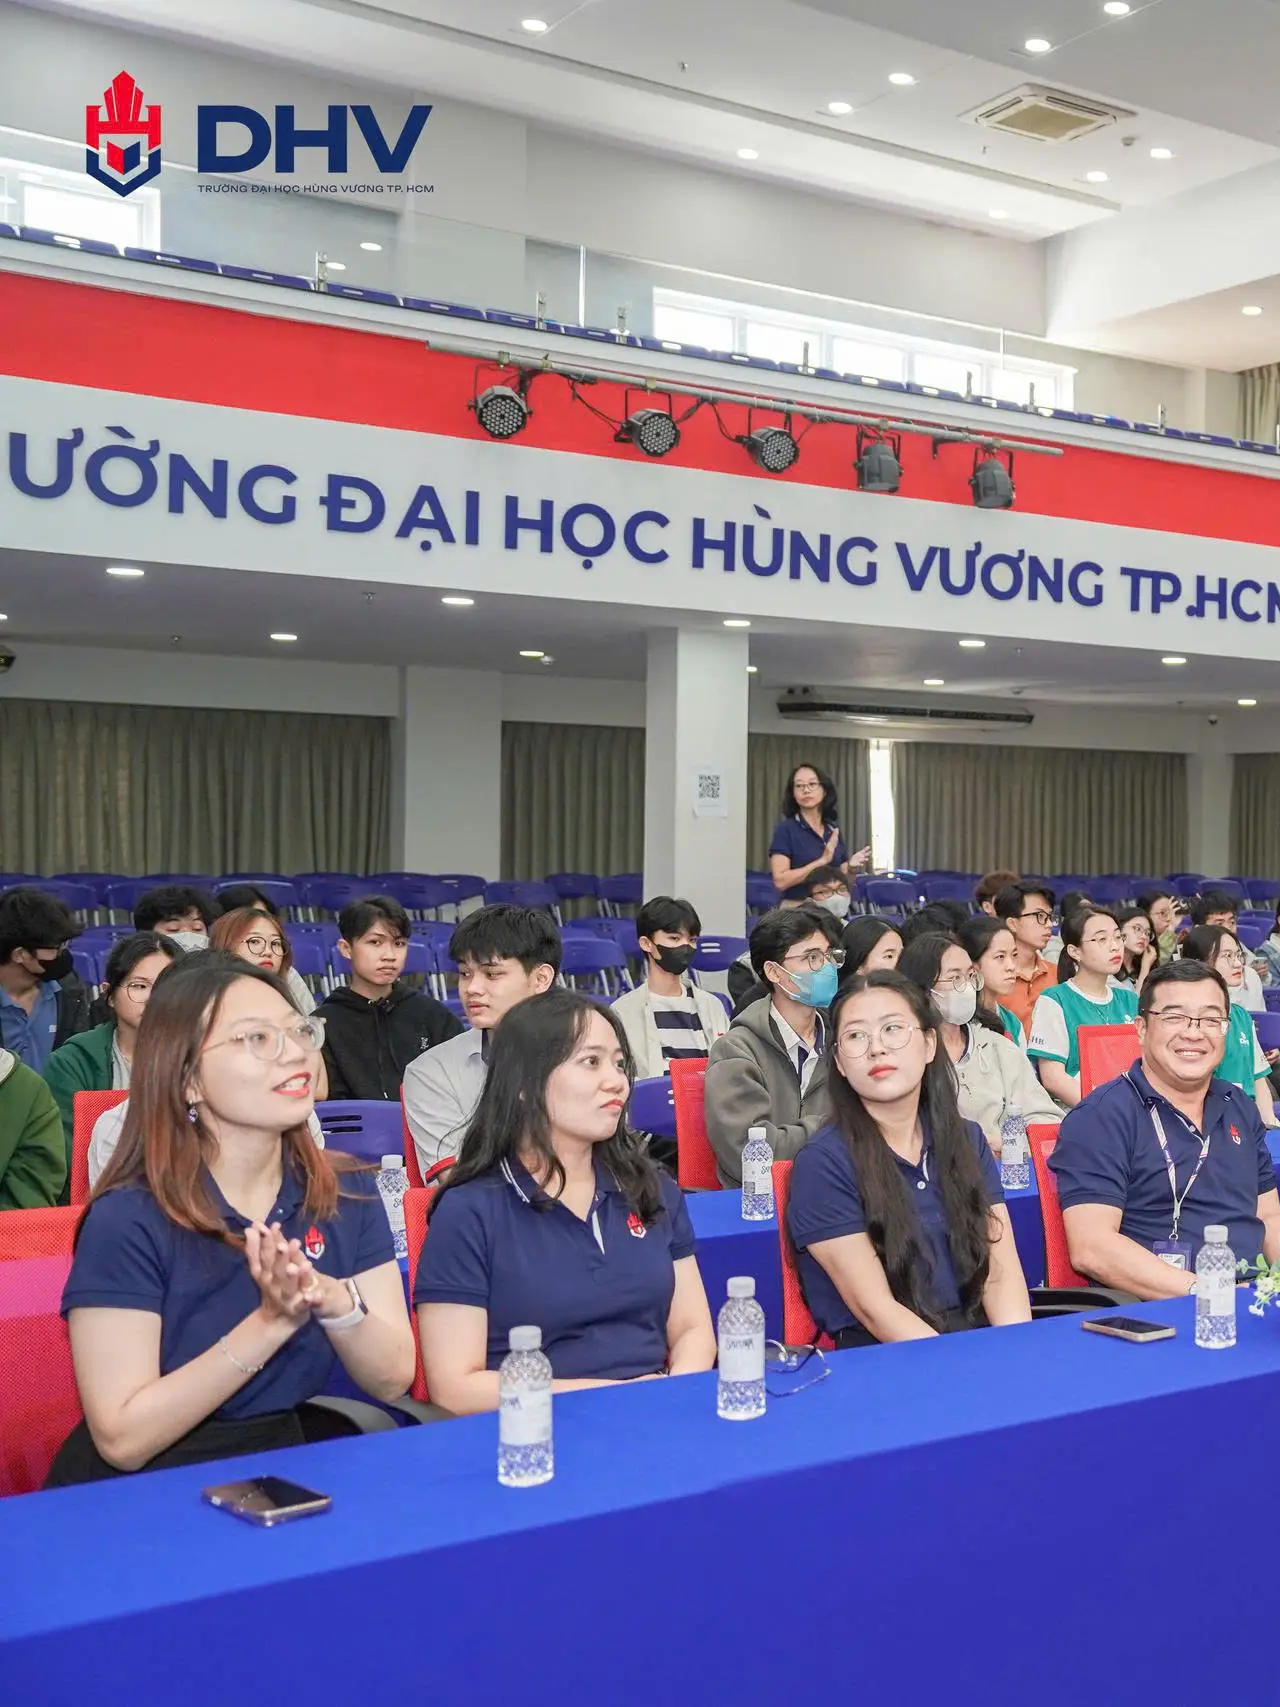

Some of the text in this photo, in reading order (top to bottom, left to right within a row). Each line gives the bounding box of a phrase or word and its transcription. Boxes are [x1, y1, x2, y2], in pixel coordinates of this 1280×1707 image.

[8, 425, 298, 526] ƯỜNG
[319, 473, 481, 552] ĐẠI
[503, 495, 671, 570] HỌC
[691, 503, 878, 587] HÙNG
[895, 540, 1104, 607] VƯƠNG
